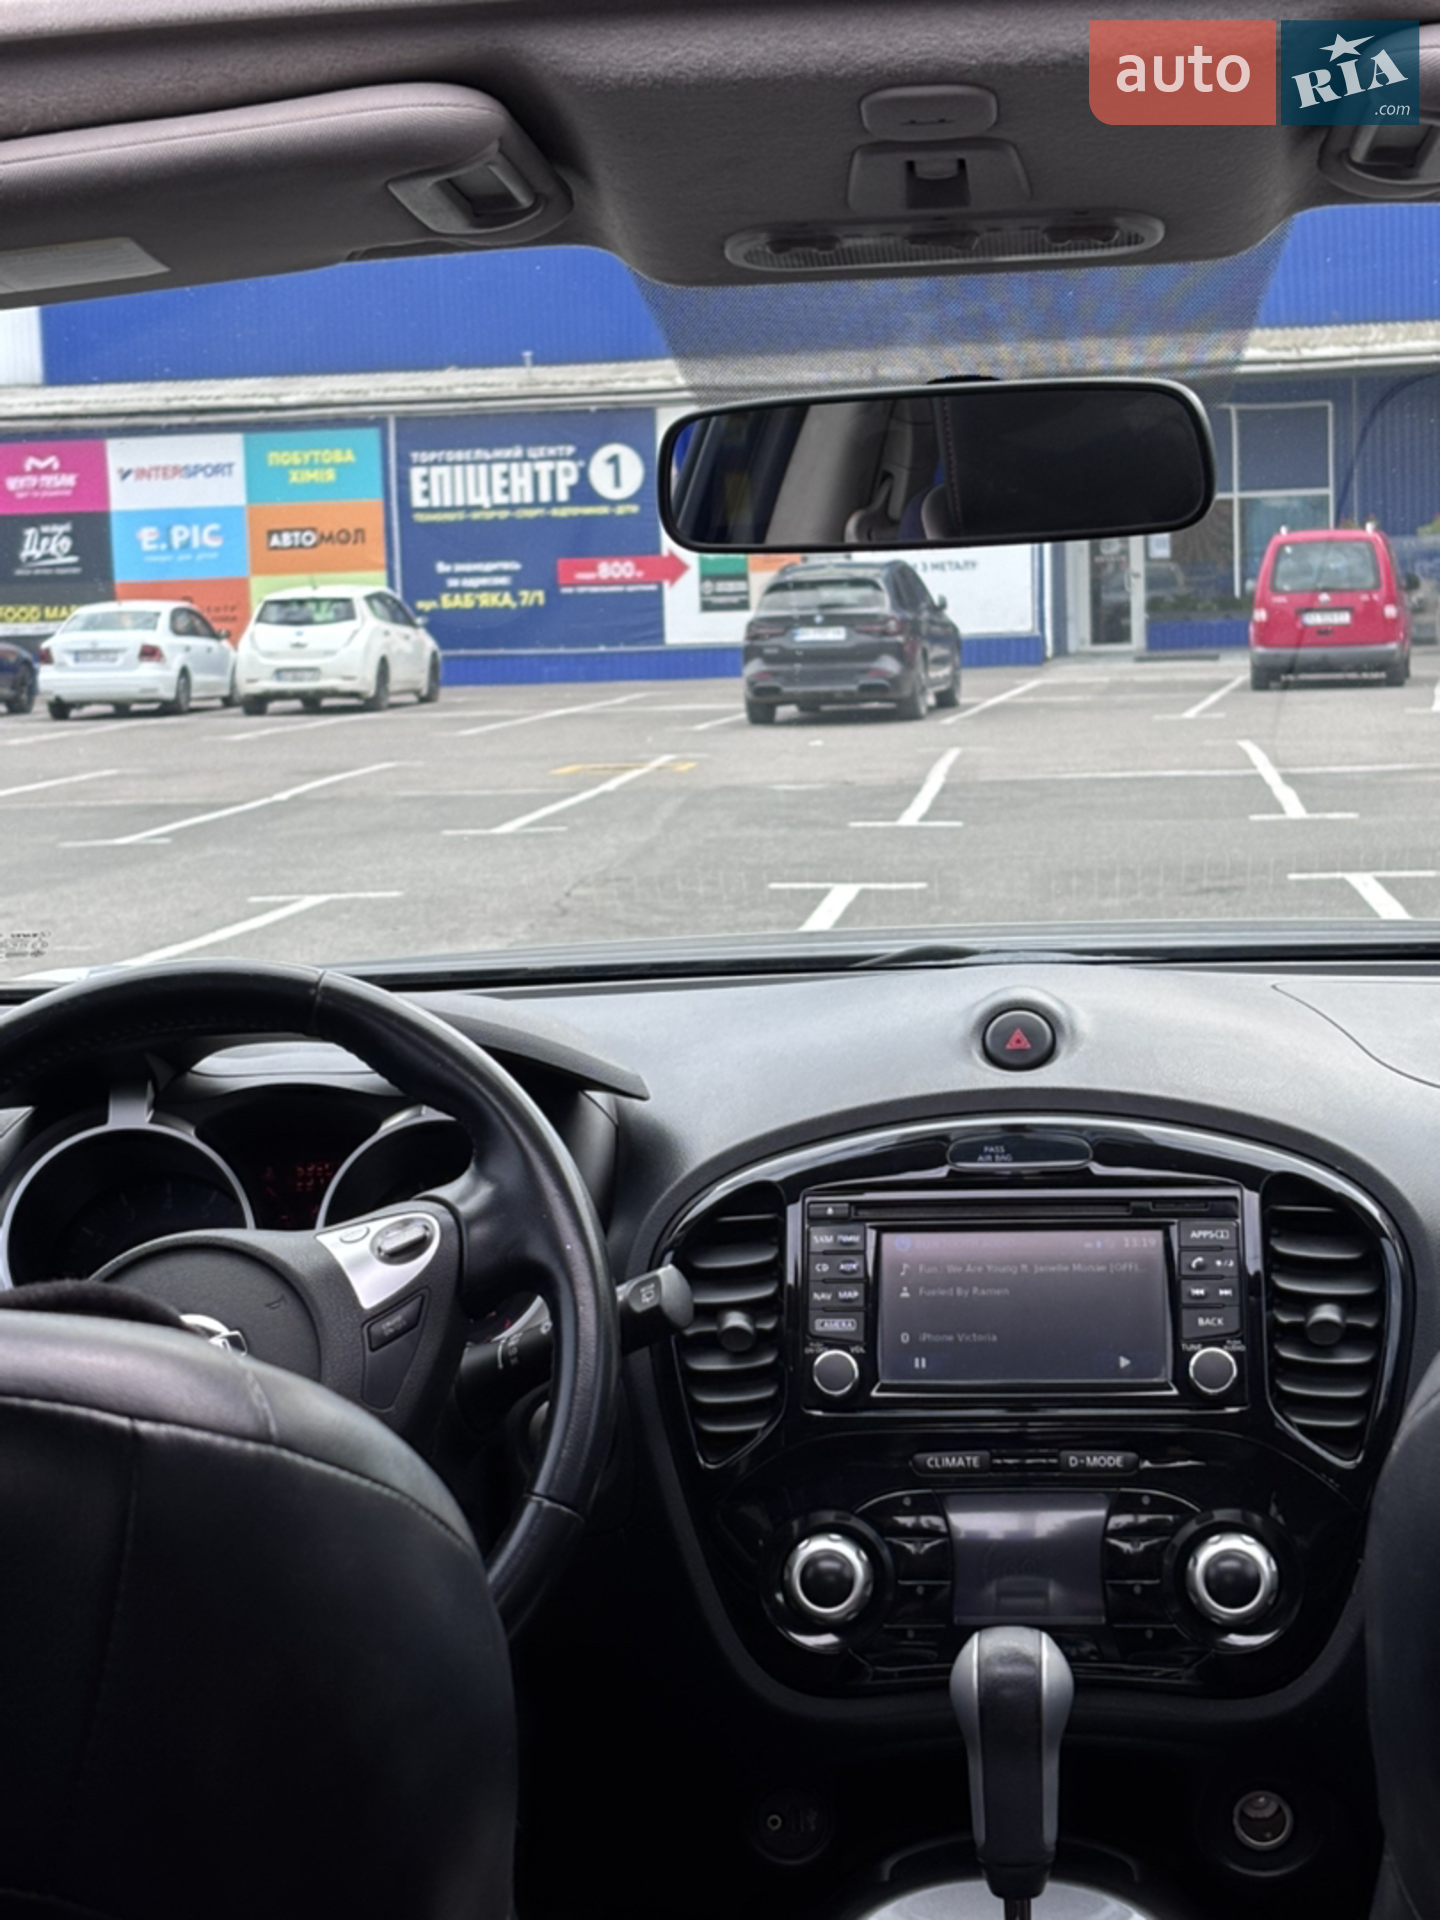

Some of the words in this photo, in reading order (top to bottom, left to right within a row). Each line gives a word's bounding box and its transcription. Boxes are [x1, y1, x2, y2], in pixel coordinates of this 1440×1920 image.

[267, 449, 355, 467] ПОБУТОВА
[526, 445, 576, 460] ЦЕНТР
[134, 462, 235, 482] INTERSPORT
[289, 468, 336, 484] ХІМІЯ
[410, 460, 580, 508] ЕПІЦЕНТР
[1197, 1316, 1225, 1327] BACK
[926, 1455, 980, 1469] CLIMATE
[1068, 1456, 1124, 1468] D-MODE
